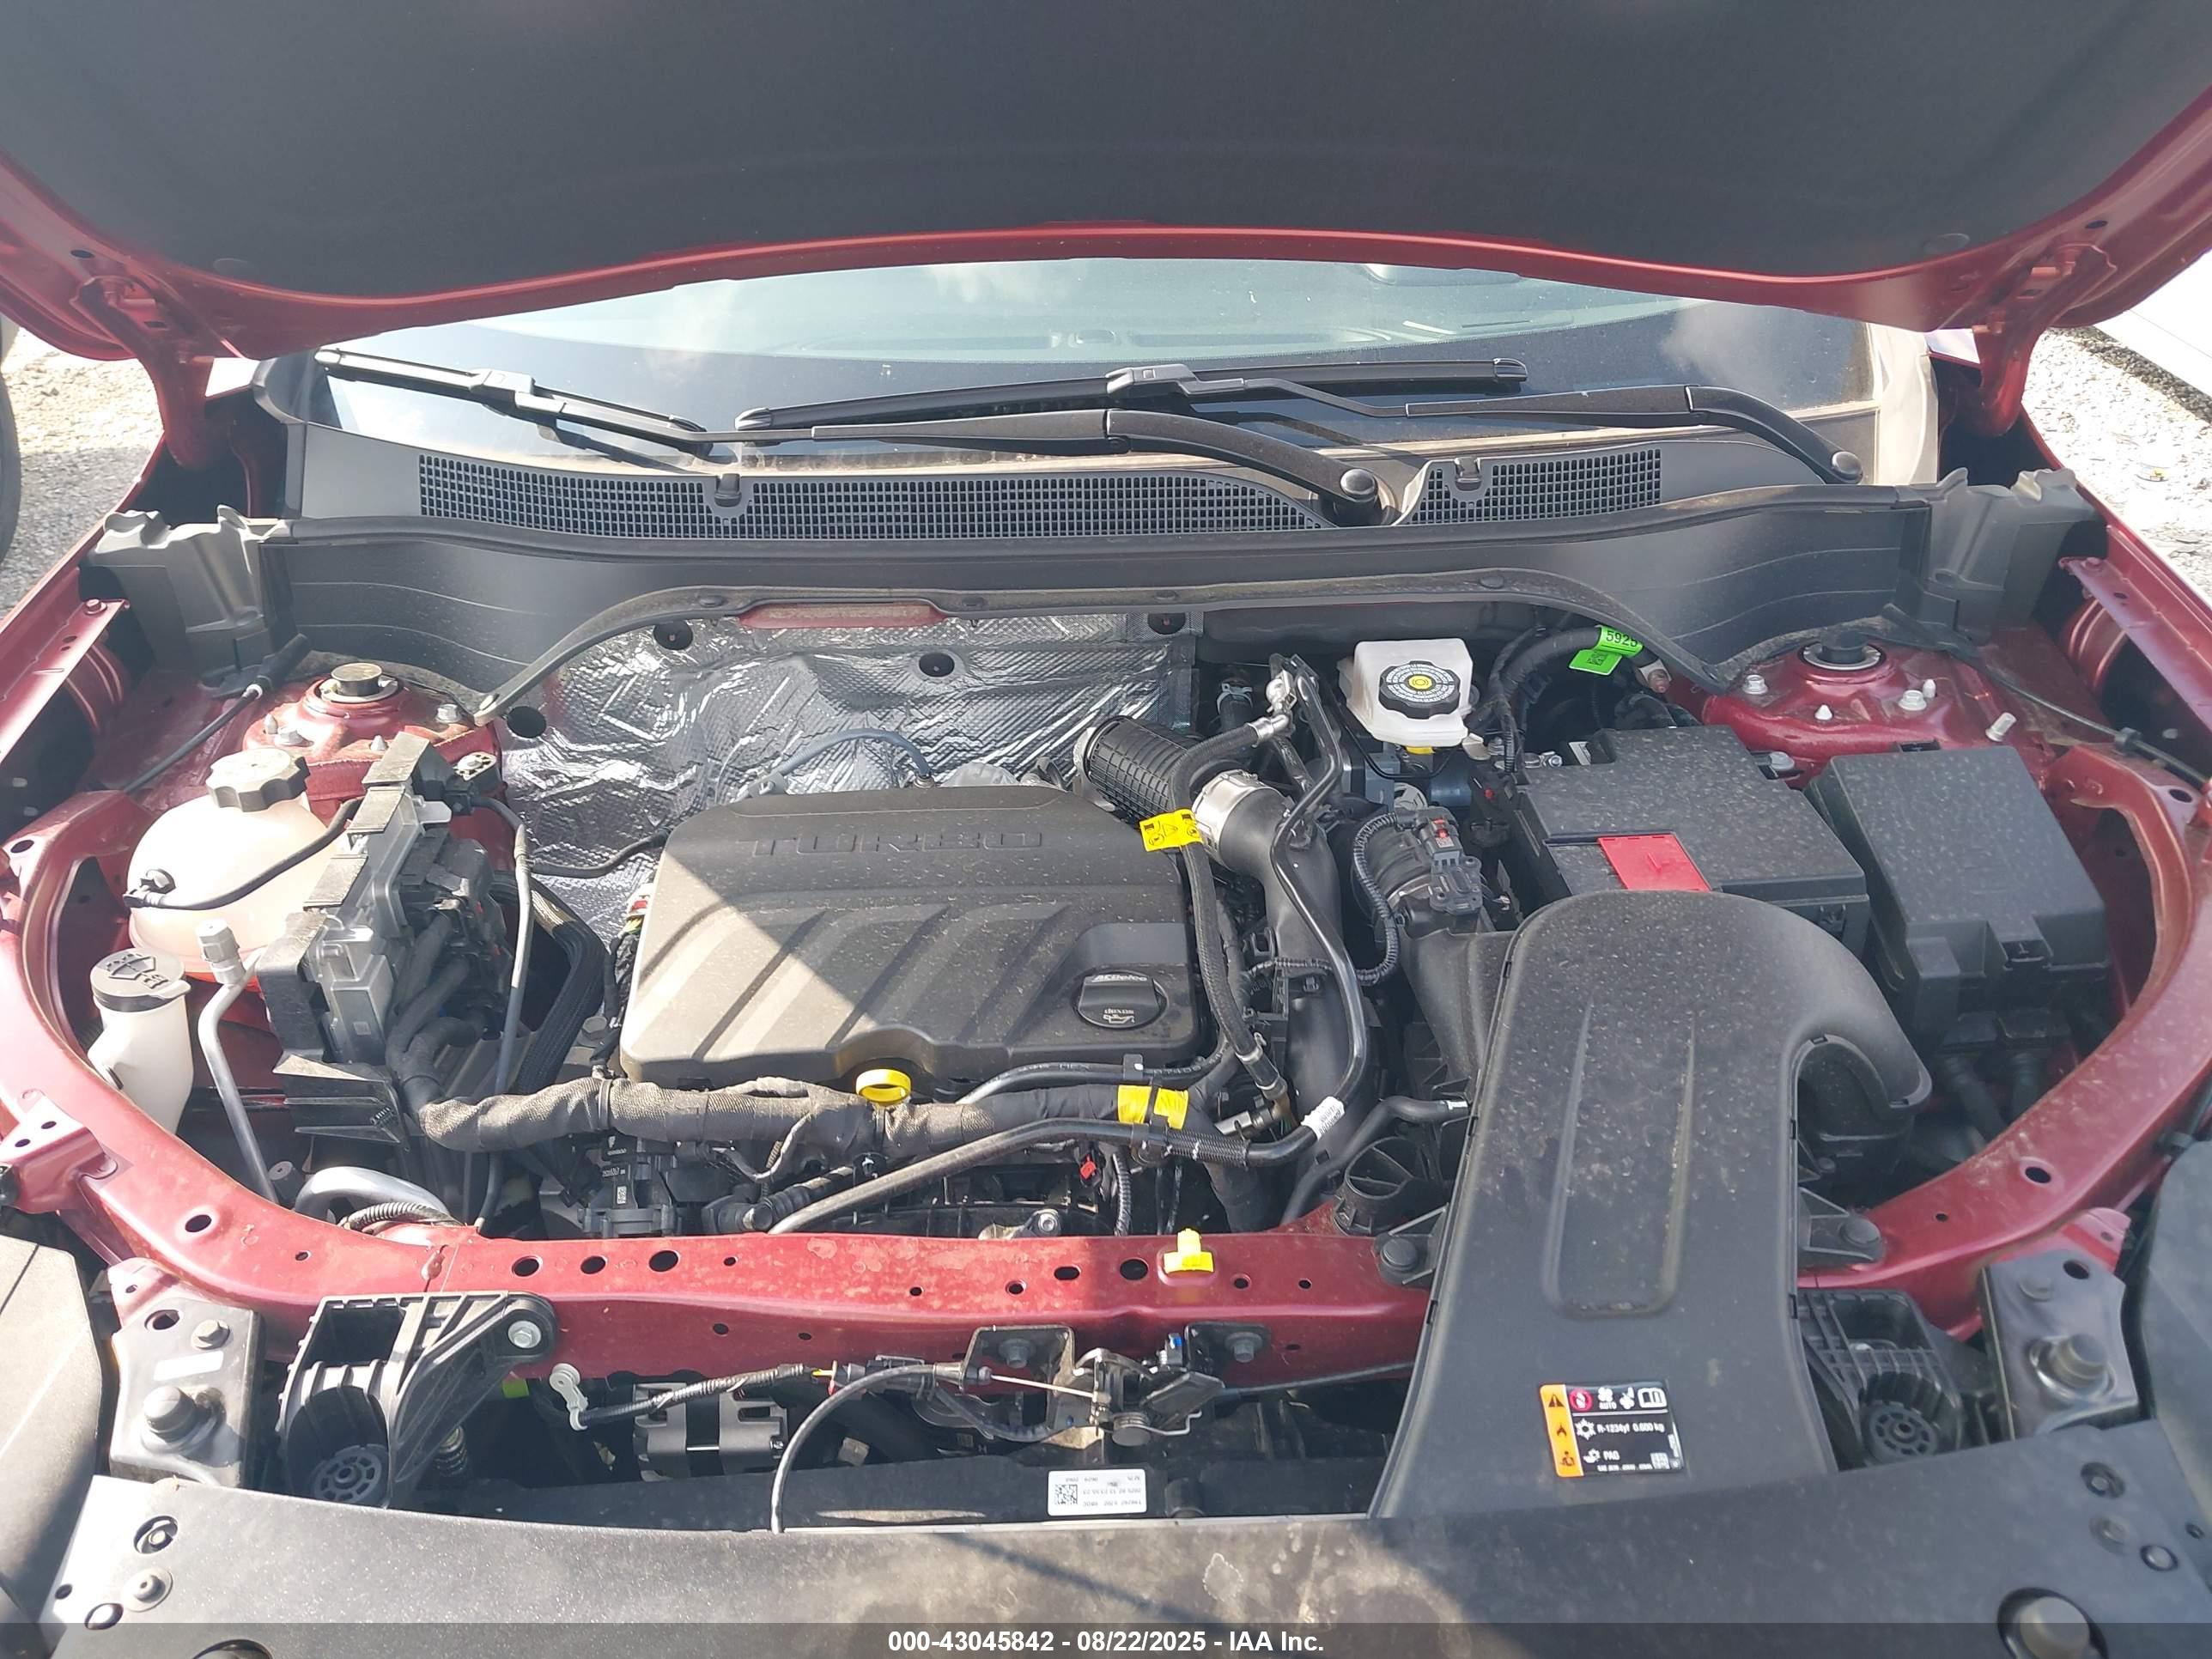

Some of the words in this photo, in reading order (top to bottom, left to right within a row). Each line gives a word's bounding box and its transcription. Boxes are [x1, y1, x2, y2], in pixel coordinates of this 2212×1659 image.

[734, 830, 1043, 857] TURBO
[1091, 974, 1148, 983] ACDelco
[1599, 1401, 1618, 1410] AUTO
[1596, 1423, 1631, 1433] R-1234yf
[1654, 1422, 1665, 1433] kg
